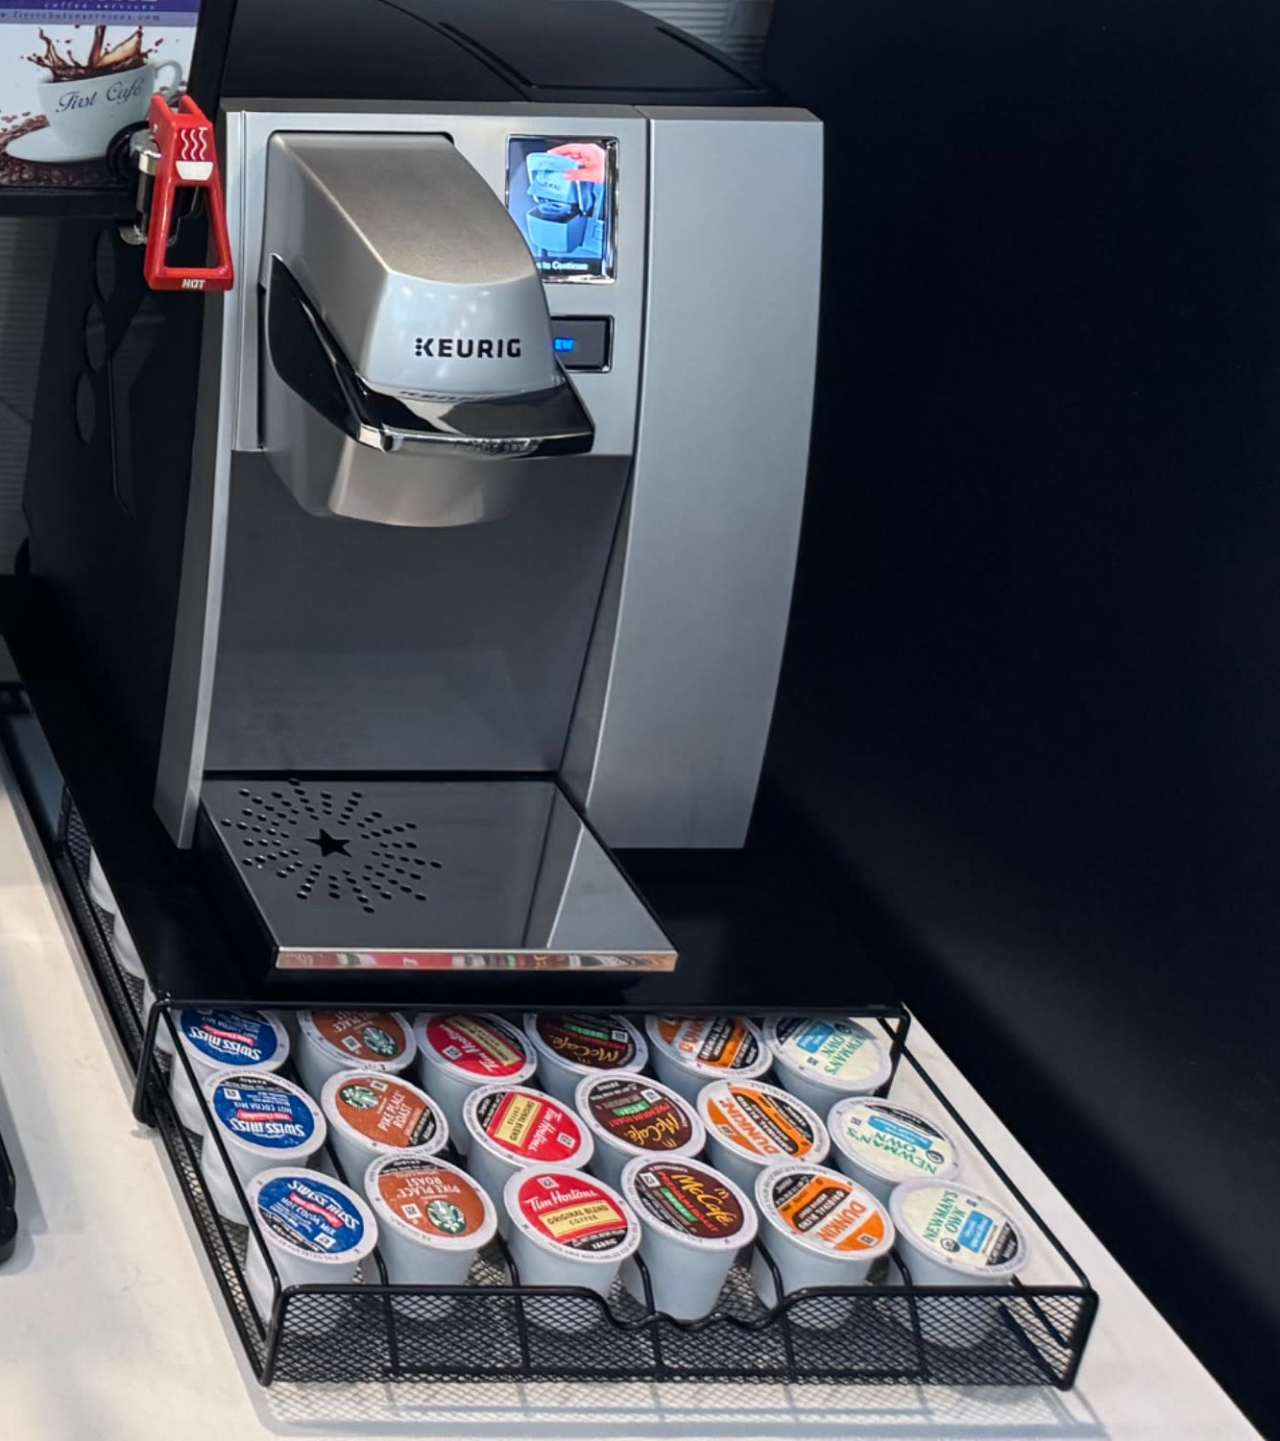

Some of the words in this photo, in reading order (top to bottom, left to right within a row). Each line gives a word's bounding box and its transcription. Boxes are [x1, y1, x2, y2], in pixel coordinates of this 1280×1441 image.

[182, 279, 205, 289] HOT
[415, 338, 521, 358] KEURIG
[875, 1132, 917, 1154] OWN
[523, 1195, 552, 1212] Tim
[945, 1206, 968, 1234] OWN
